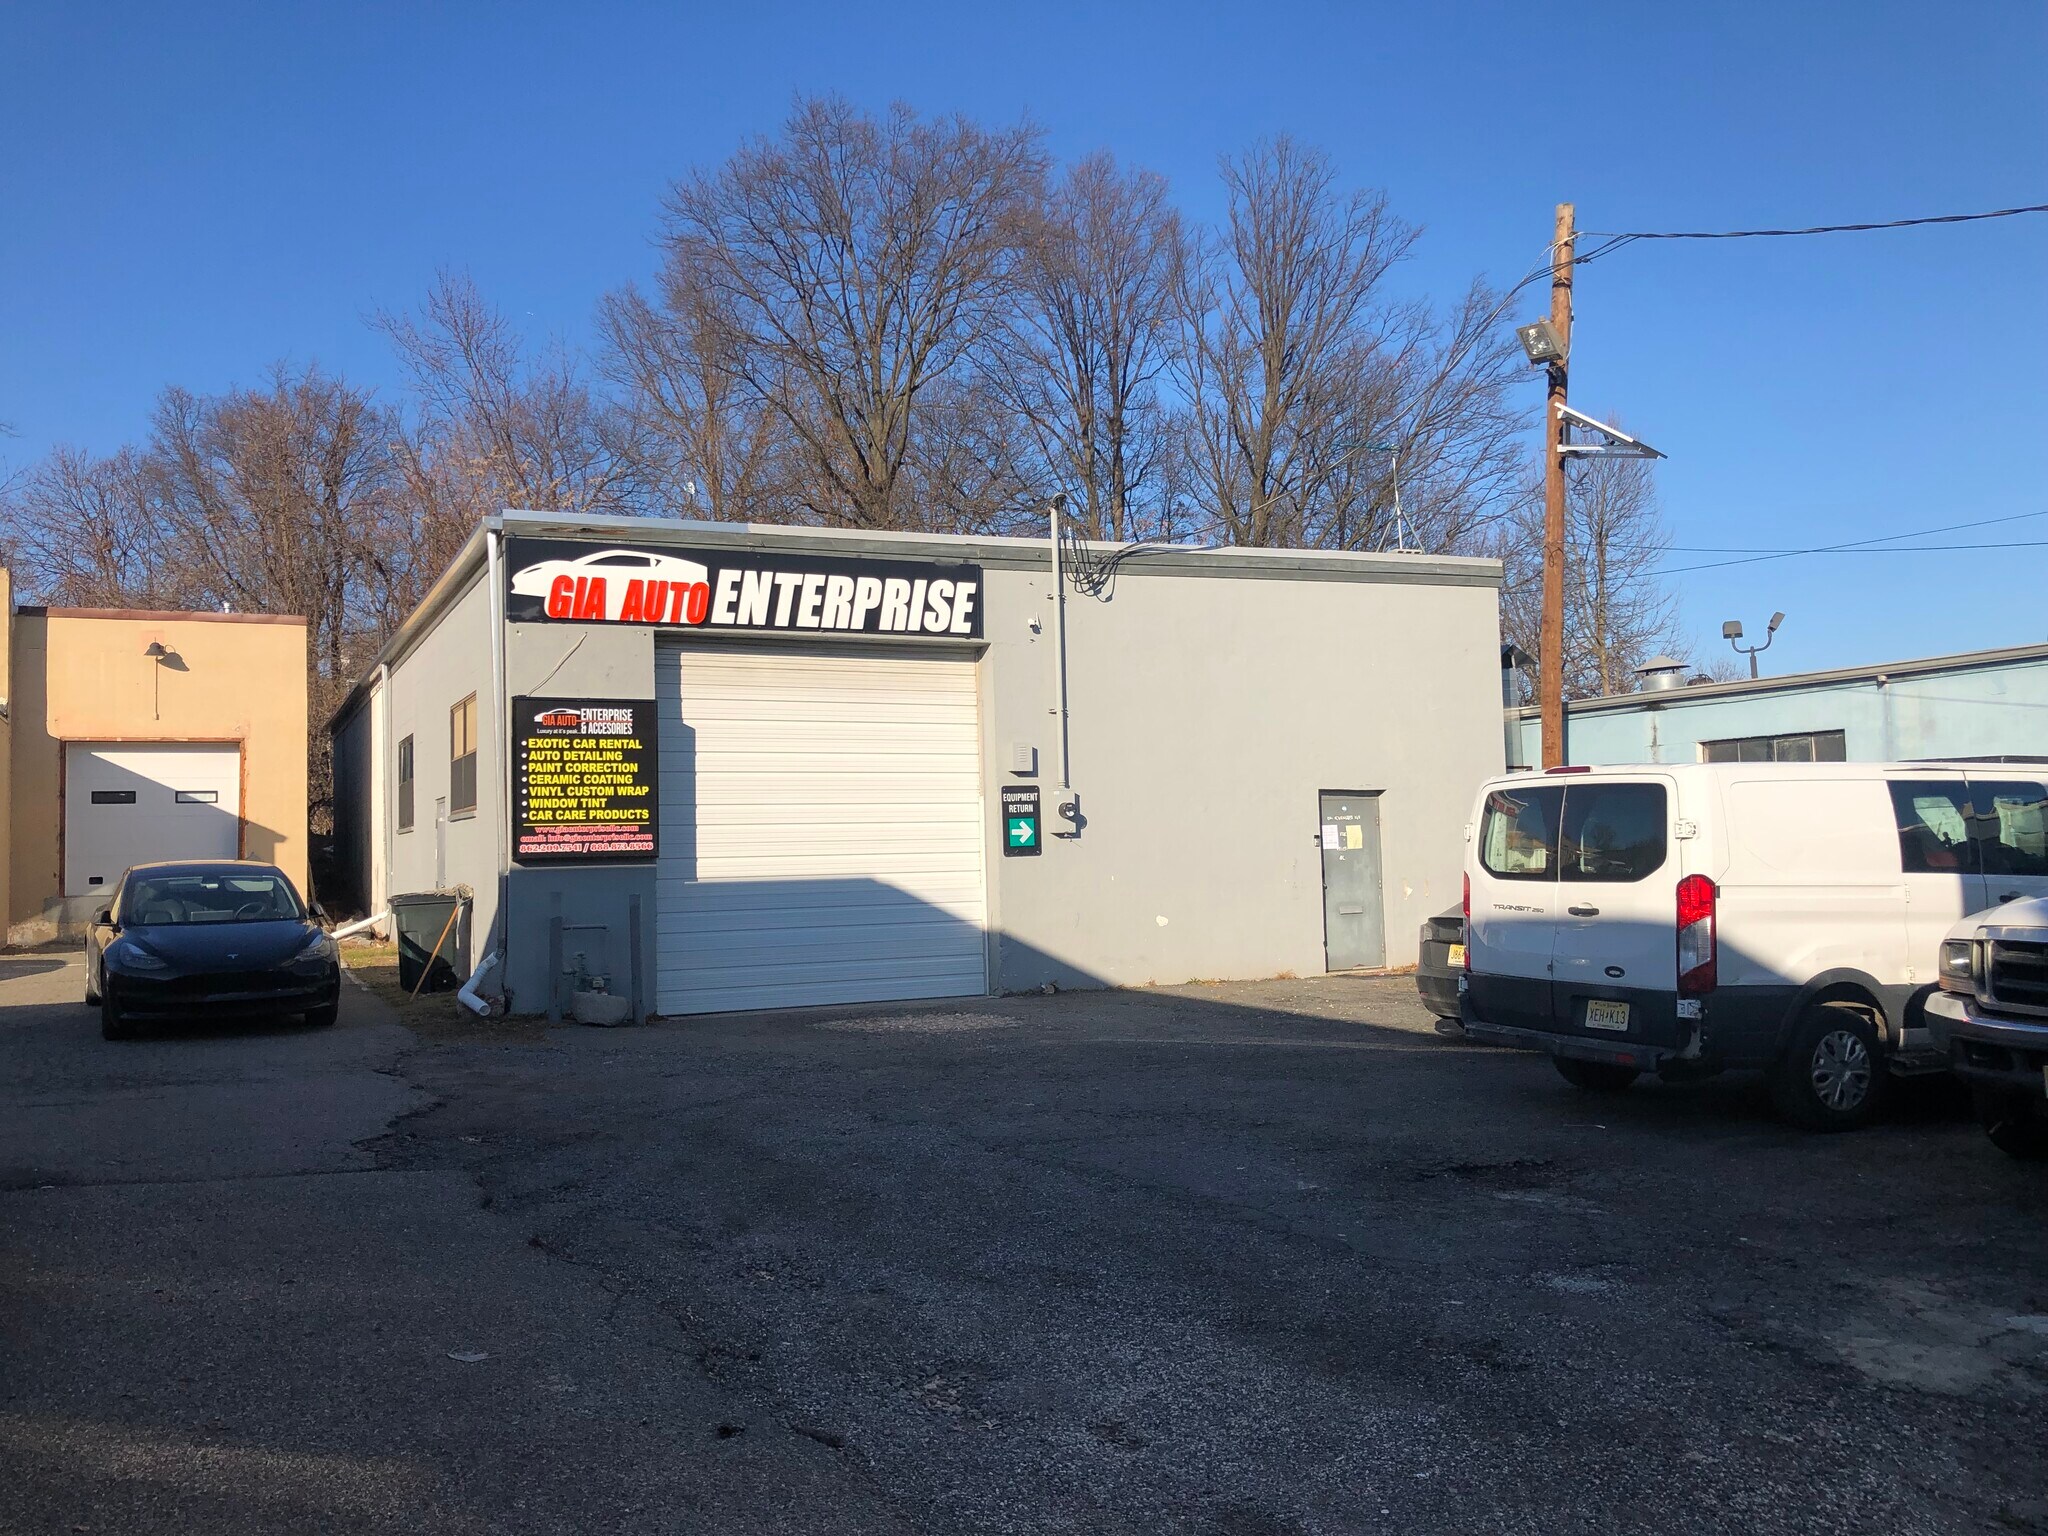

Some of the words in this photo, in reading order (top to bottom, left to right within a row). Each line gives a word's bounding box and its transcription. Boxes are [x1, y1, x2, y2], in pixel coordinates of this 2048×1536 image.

[547, 574, 607, 620] GIA
[619, 578, 710, 625] AUTO
[711, 568, 977, 634] ENTERPRISE
[542, 715, 556, 727] GIA
[557, 715, 577, 727] AUTO
[580, 708, 633, 721] ENTERPRISE
[580, 722, 587, 735] &
[588, 722, 633, 735] ACCESORIES
[528, 738, 570, 749] EXOTIC
[573, 739, 597, 749] CAR
[599, 739, 643, 749] RENTAL
[528, 751, 560, 761] AUTO
[563, 751, 623, 761] DETAILING
[528, 763, 562, 773] PAINT
[565, 763, 638, 773] CORRECTION
[528, 775, 581, 784] CERAMIC
[583, 775, 633, 784] COATING
[529, 786, 565, 796] VINYL
[567, 786, 614, 796] CUSTOM
[617, 786, 649, 796] WRAP
[1003, 792, 1038, 802] EQUIPMENT
[529, 798, 578, 808] WINDOW
[580, 798, 607, 808] TINT
[1008, 804, 1034, 813] RETURN
[529, 810, 553, 820] CAR
[555, 810, 587, 820] CARE
[589, 809, 650, 819] PRODUCTS
[520, 834, 547, 843] email:
[519, 843, 582, 853] 862.209.7541
[590, 842, 654, 851] 888.873.8566
